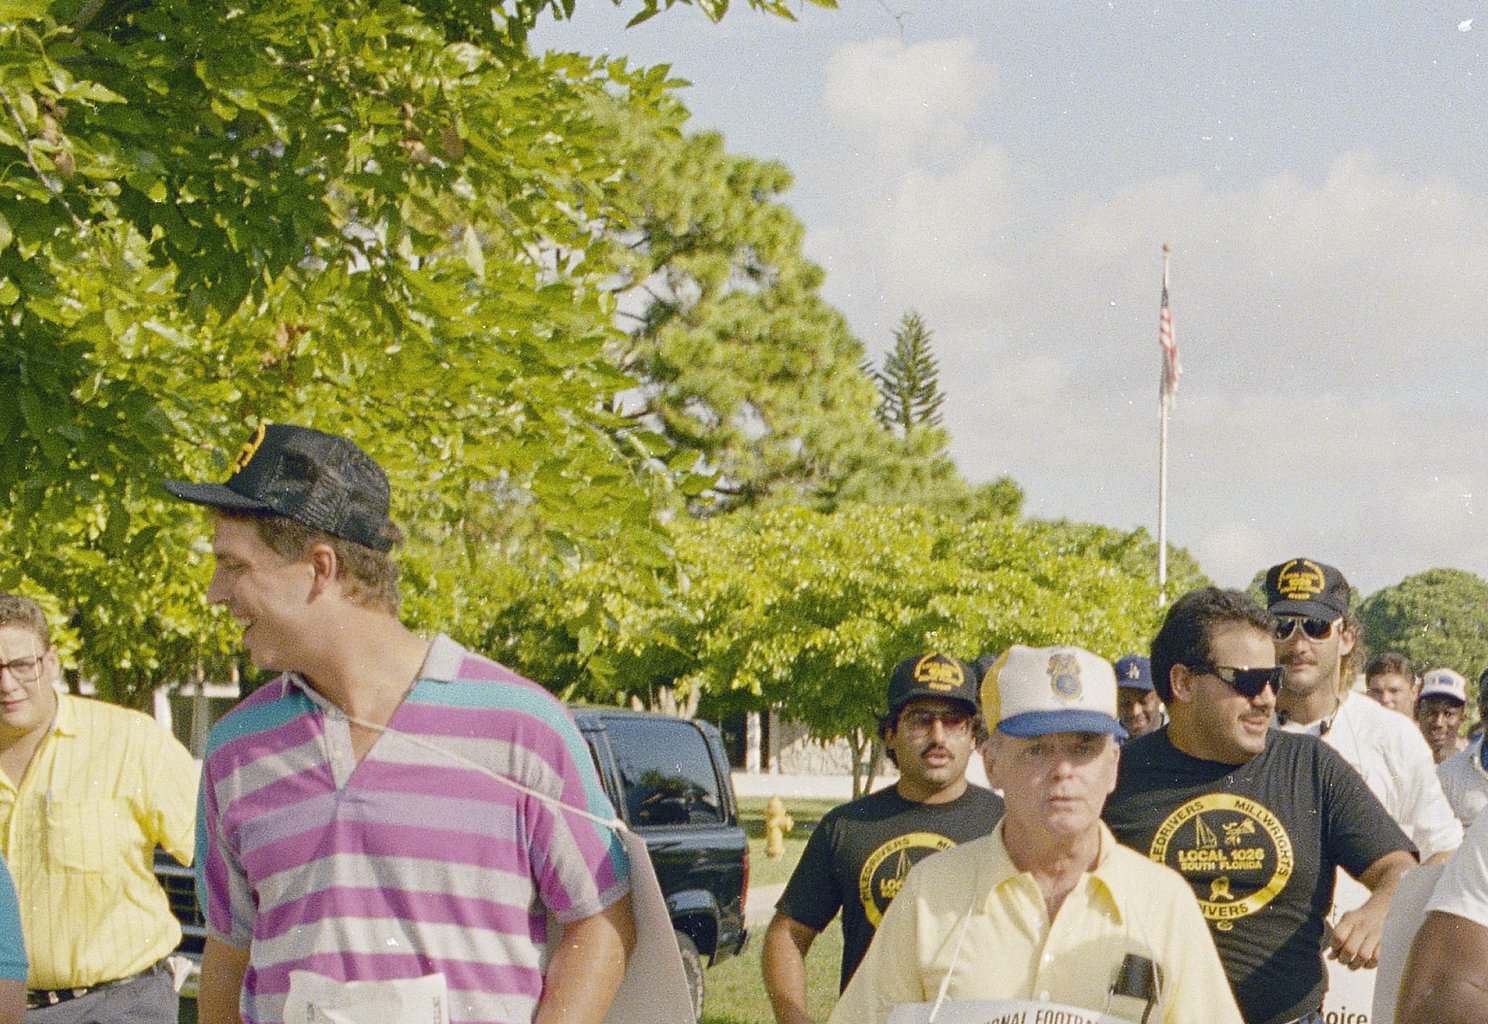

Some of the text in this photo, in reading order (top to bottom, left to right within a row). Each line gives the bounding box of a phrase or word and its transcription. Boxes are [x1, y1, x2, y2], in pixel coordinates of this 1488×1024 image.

[1234, 801, 1291, 876] MILLWRIGHTS
[1178, 848, 1265, 862] LOCAL 1026
[1181, 861, 1262, 871] SOUTH FLORIDA
[1199, 903, 1249, 917] IVERS
